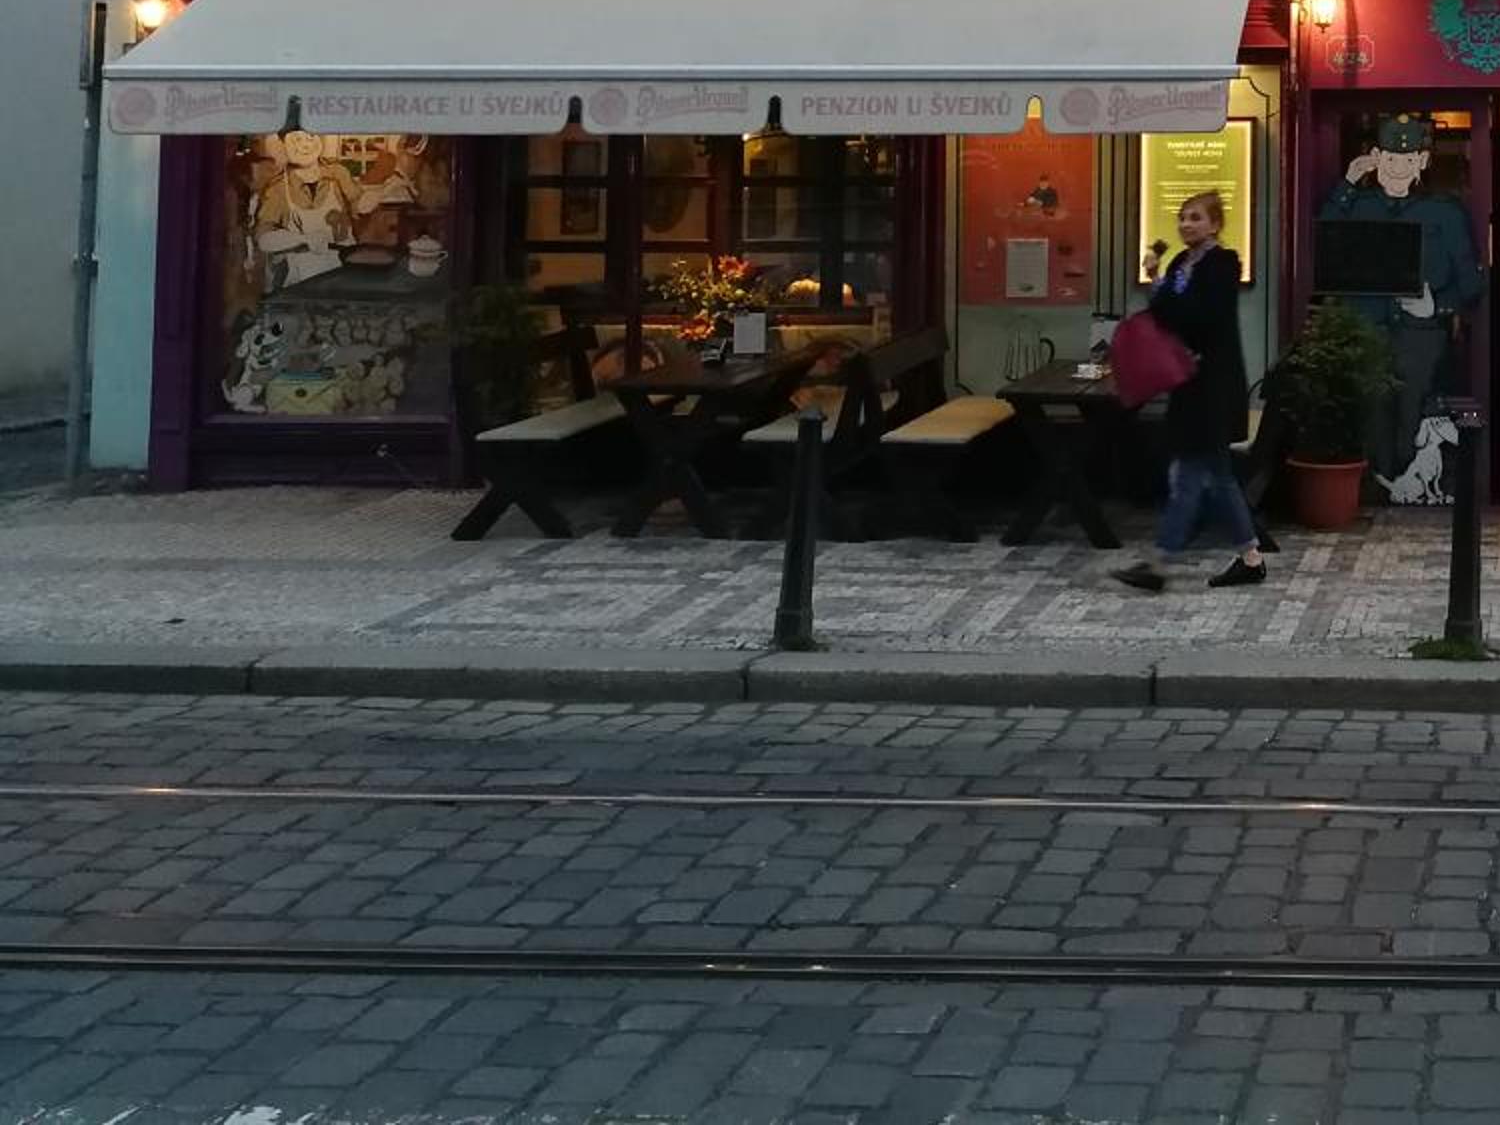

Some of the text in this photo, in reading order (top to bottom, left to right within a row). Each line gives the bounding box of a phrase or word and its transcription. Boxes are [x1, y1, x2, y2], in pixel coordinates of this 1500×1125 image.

[308, 89, 563, 116] RESTAURACE U ŠVEJKŮ
[801, 91, 1012, 116] PENZION U ŠVEJKŮ
